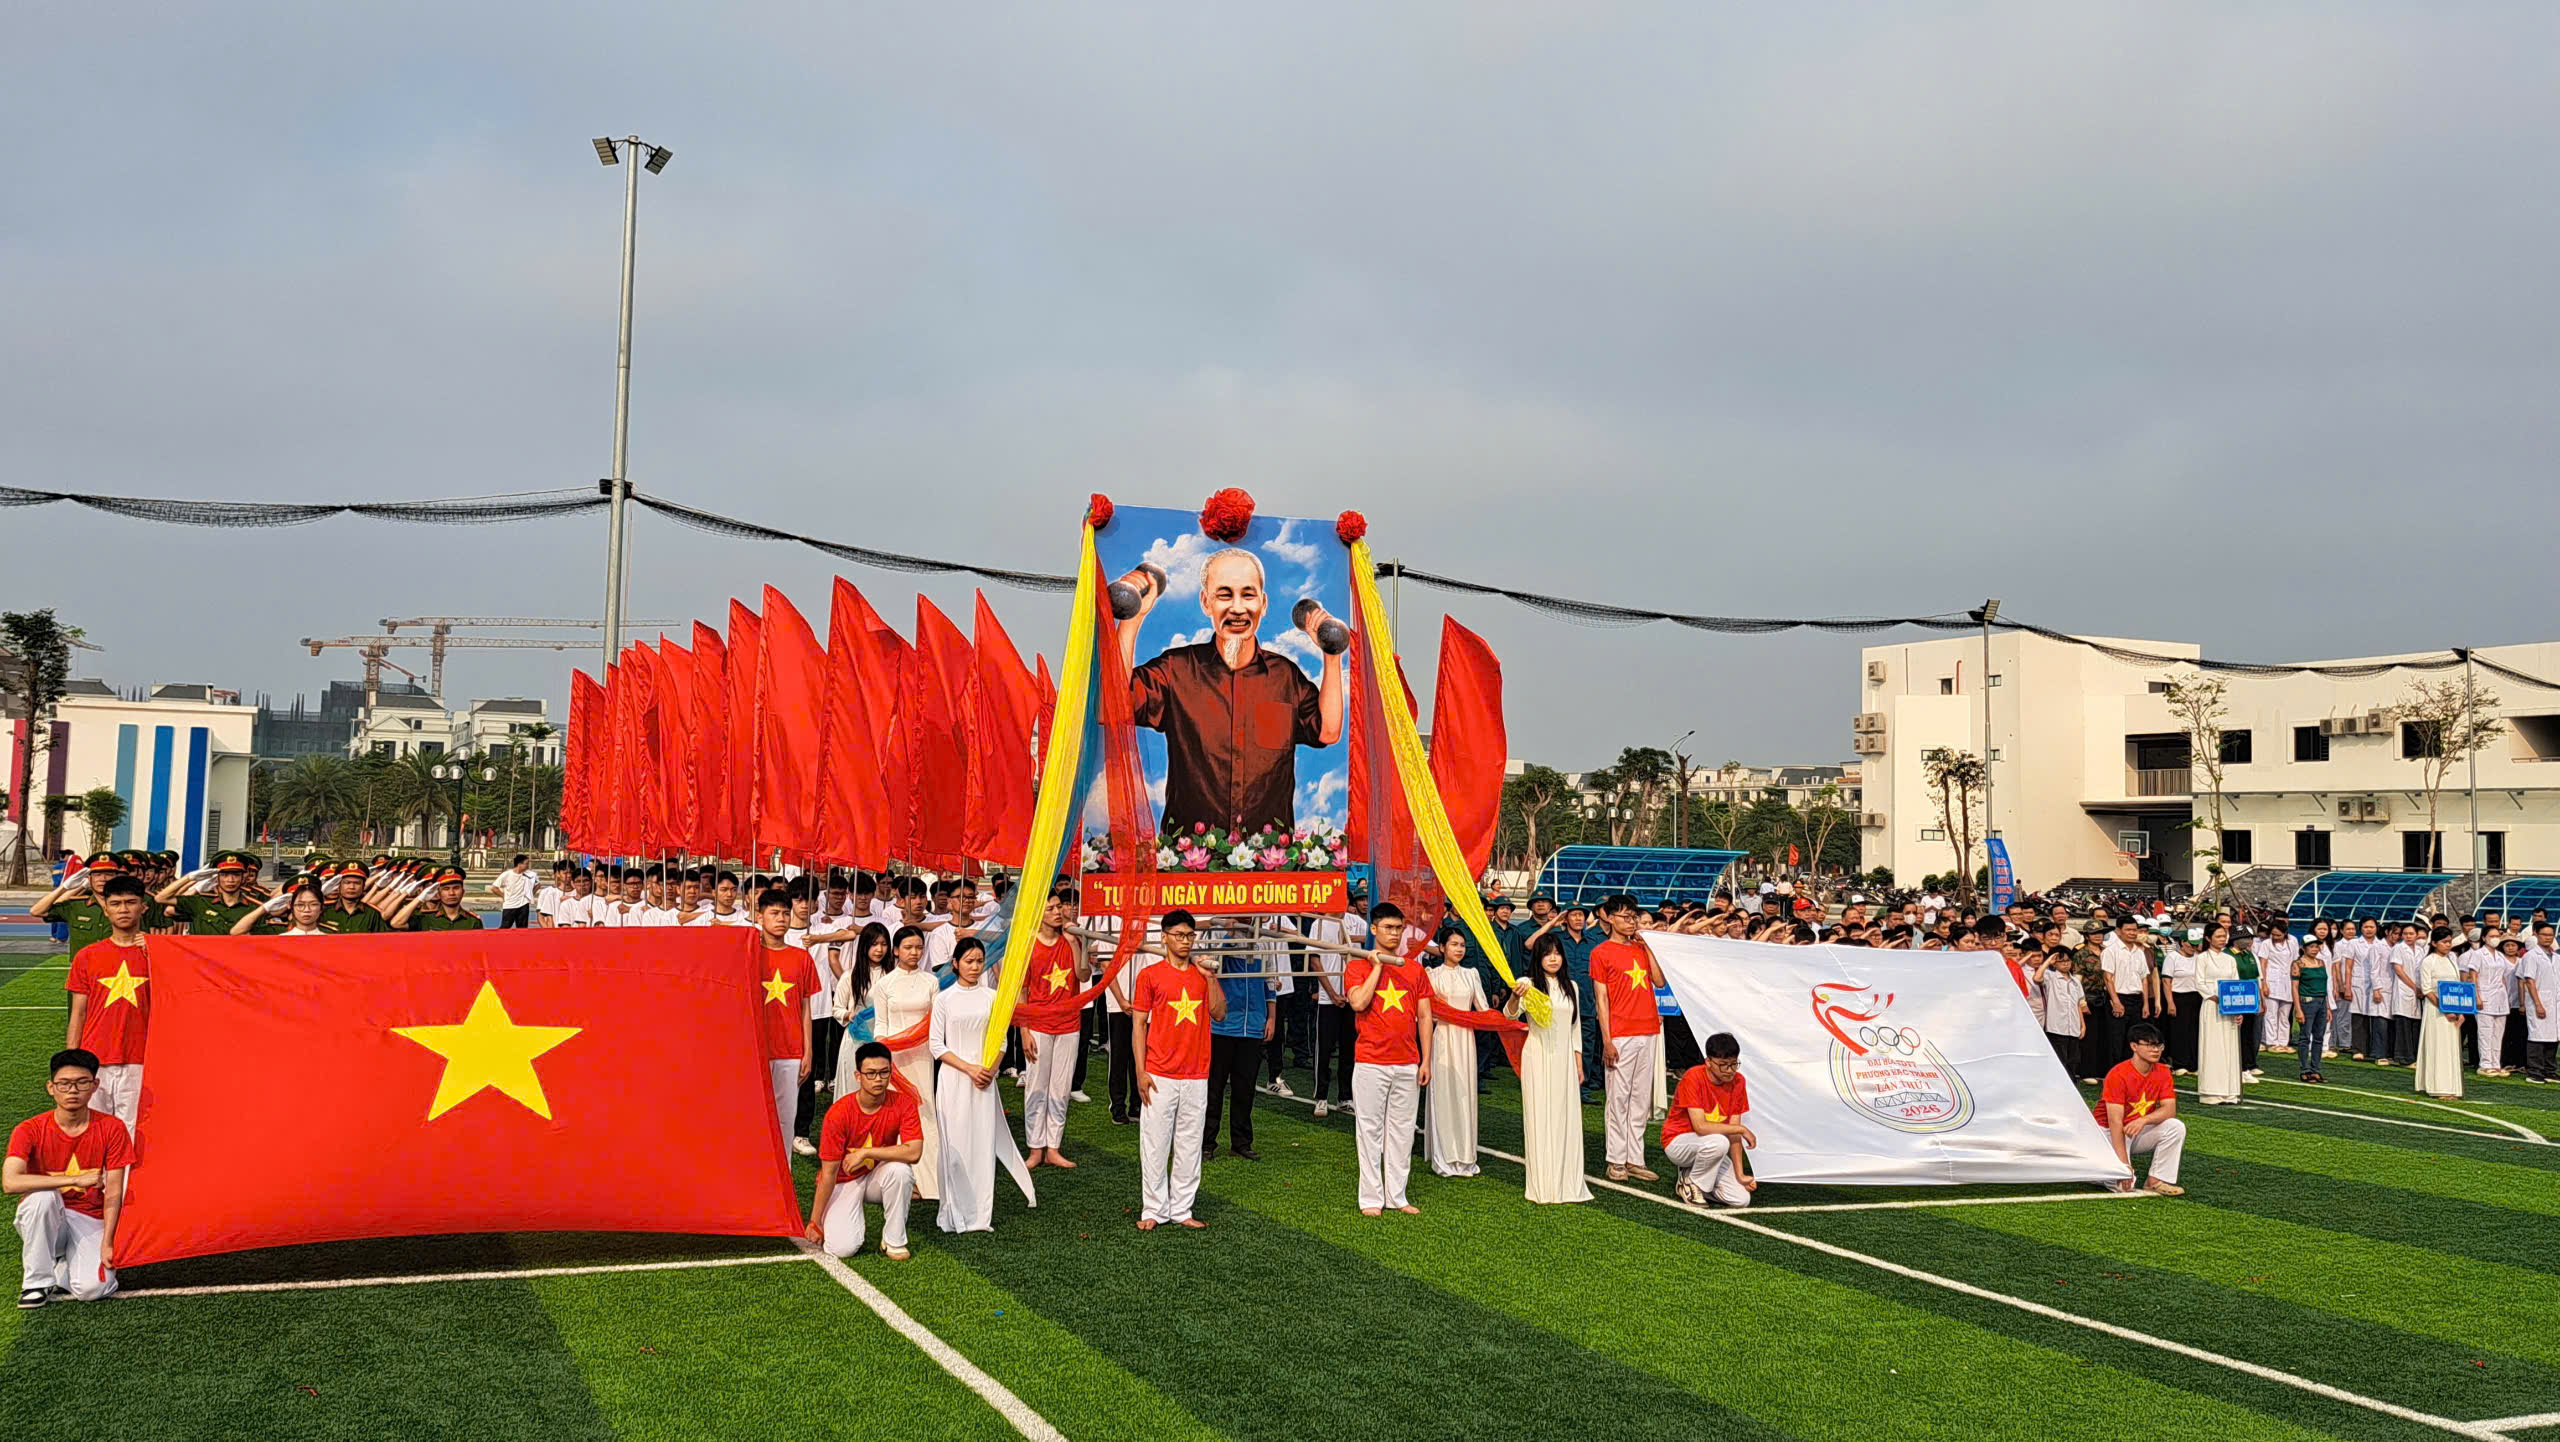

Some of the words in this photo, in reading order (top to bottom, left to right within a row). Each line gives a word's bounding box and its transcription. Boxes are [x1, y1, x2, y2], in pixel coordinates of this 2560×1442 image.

[1161, 879, 1208, 906] NGÀY
[1212, 879, 1248, 906] NÀO
[1252, 879, 1298, 905] CŨNG
[1900, 1104, 1941, 1117] 2026
